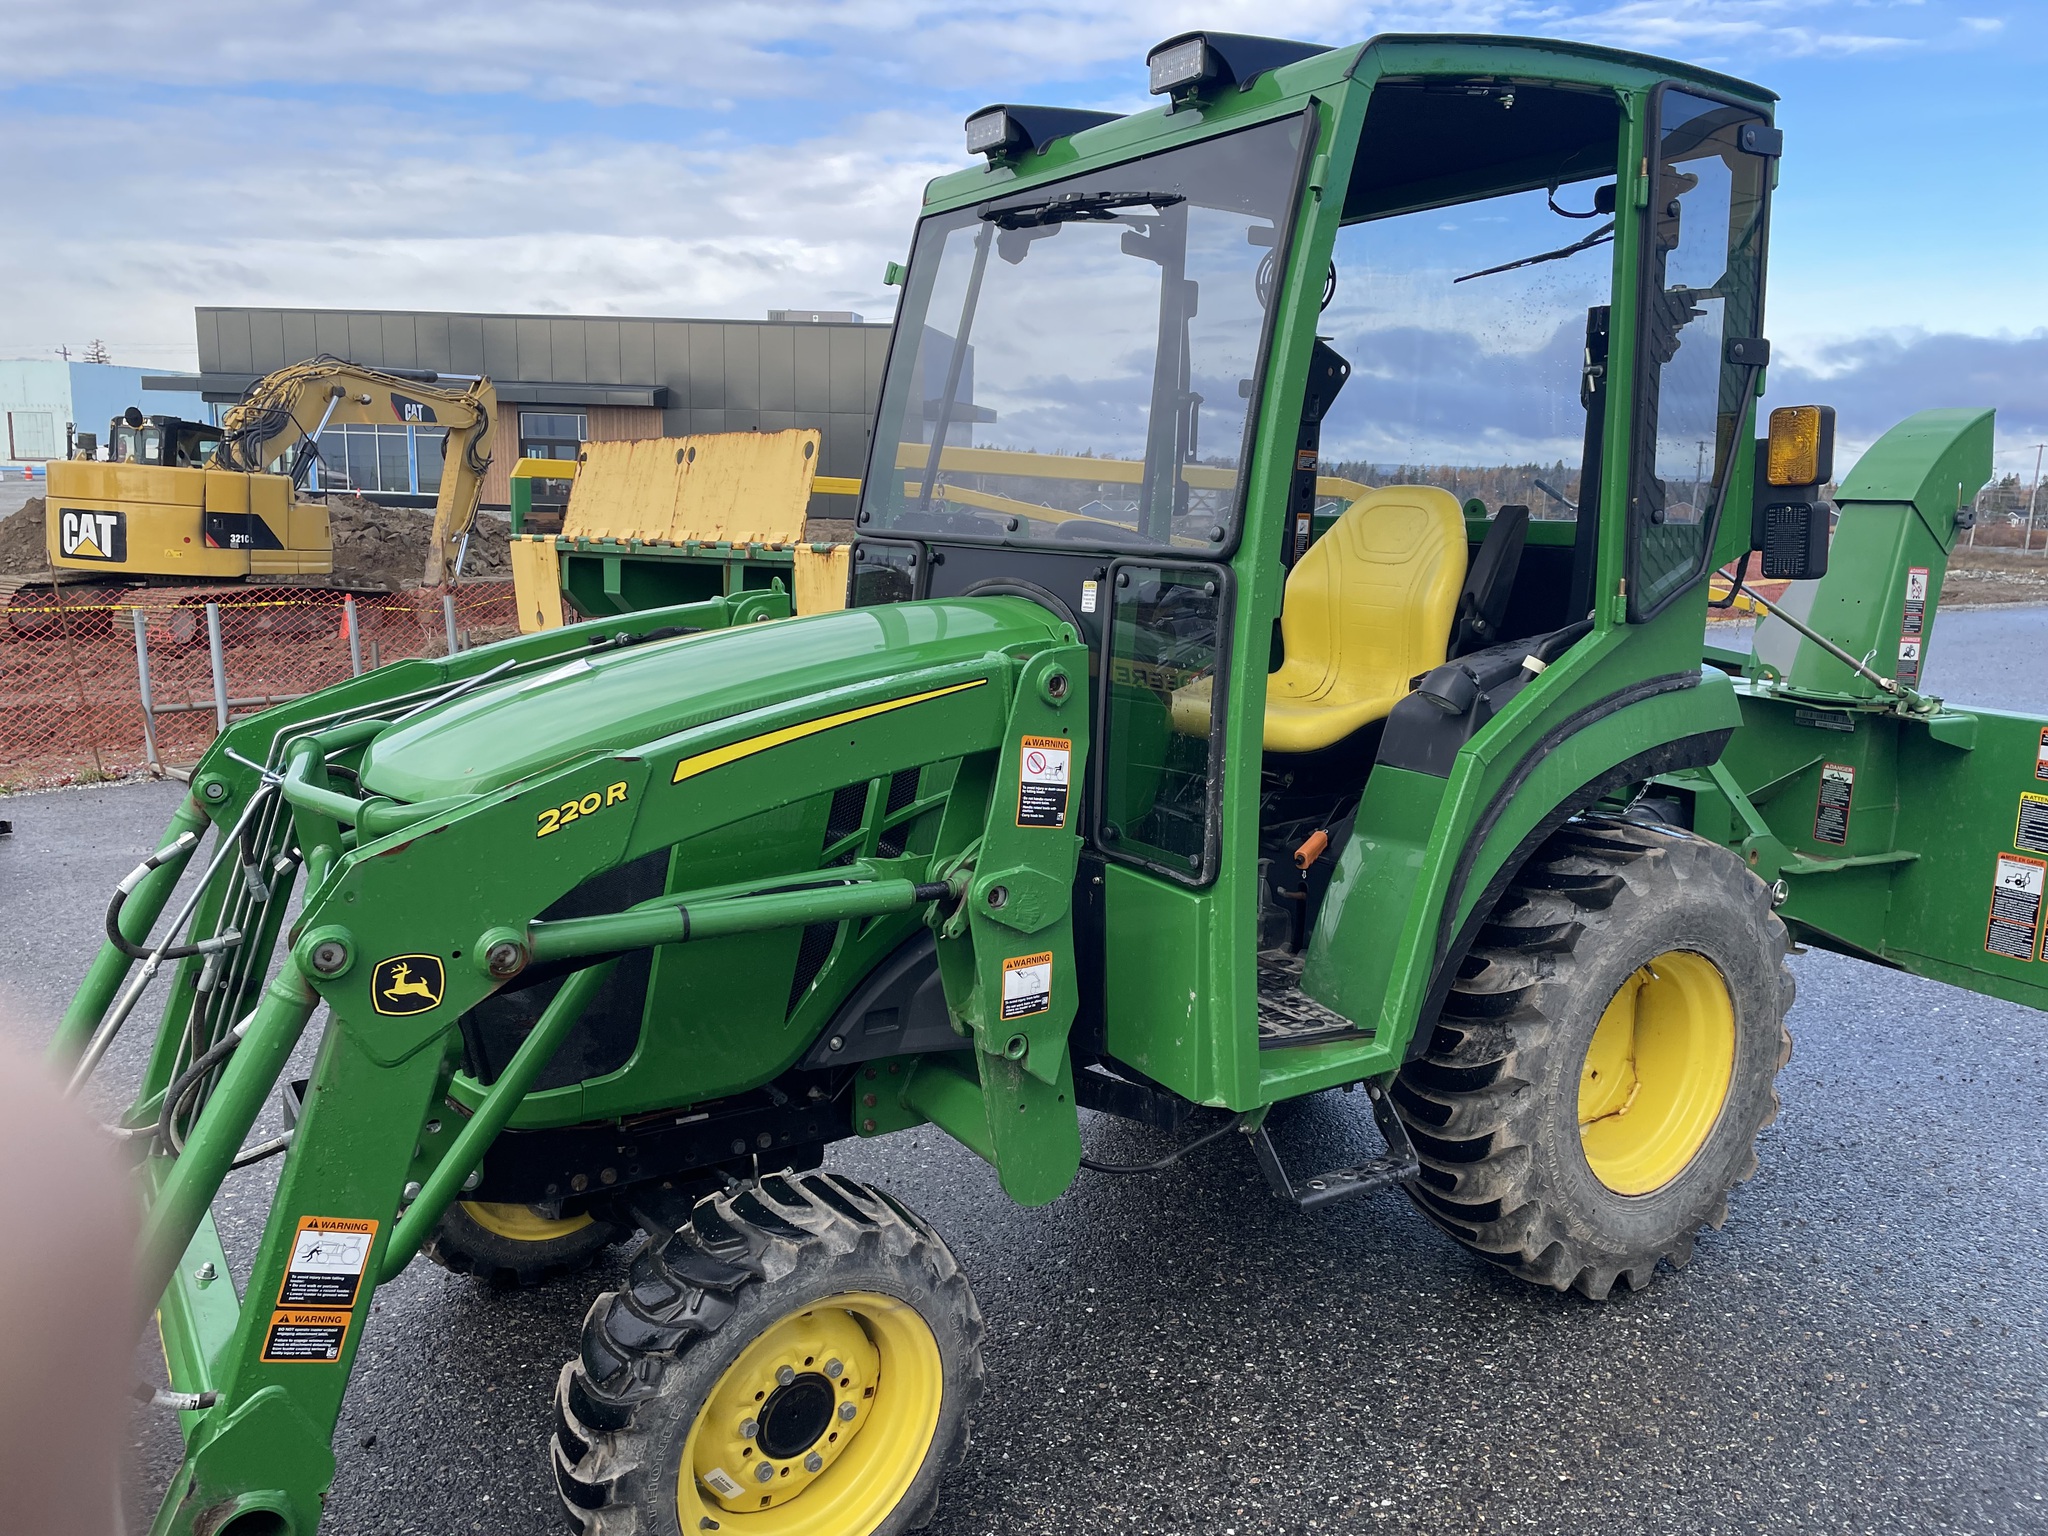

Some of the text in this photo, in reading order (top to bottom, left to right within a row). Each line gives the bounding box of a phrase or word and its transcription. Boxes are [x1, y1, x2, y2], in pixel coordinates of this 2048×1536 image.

[405, 403, 424, 422] CAT
[63, 512, 117, 557] CAT
[1032, 738, 1069, 749] WARNING
[1829, 764, 1853, 772] DANGER
[536, 780, 629, 839] 220R
[1013, 954, 1050, 967] WARNING
[321, 1221, 369, 1231] WARNING
[294, 1314, 342, 1324] WARNING
